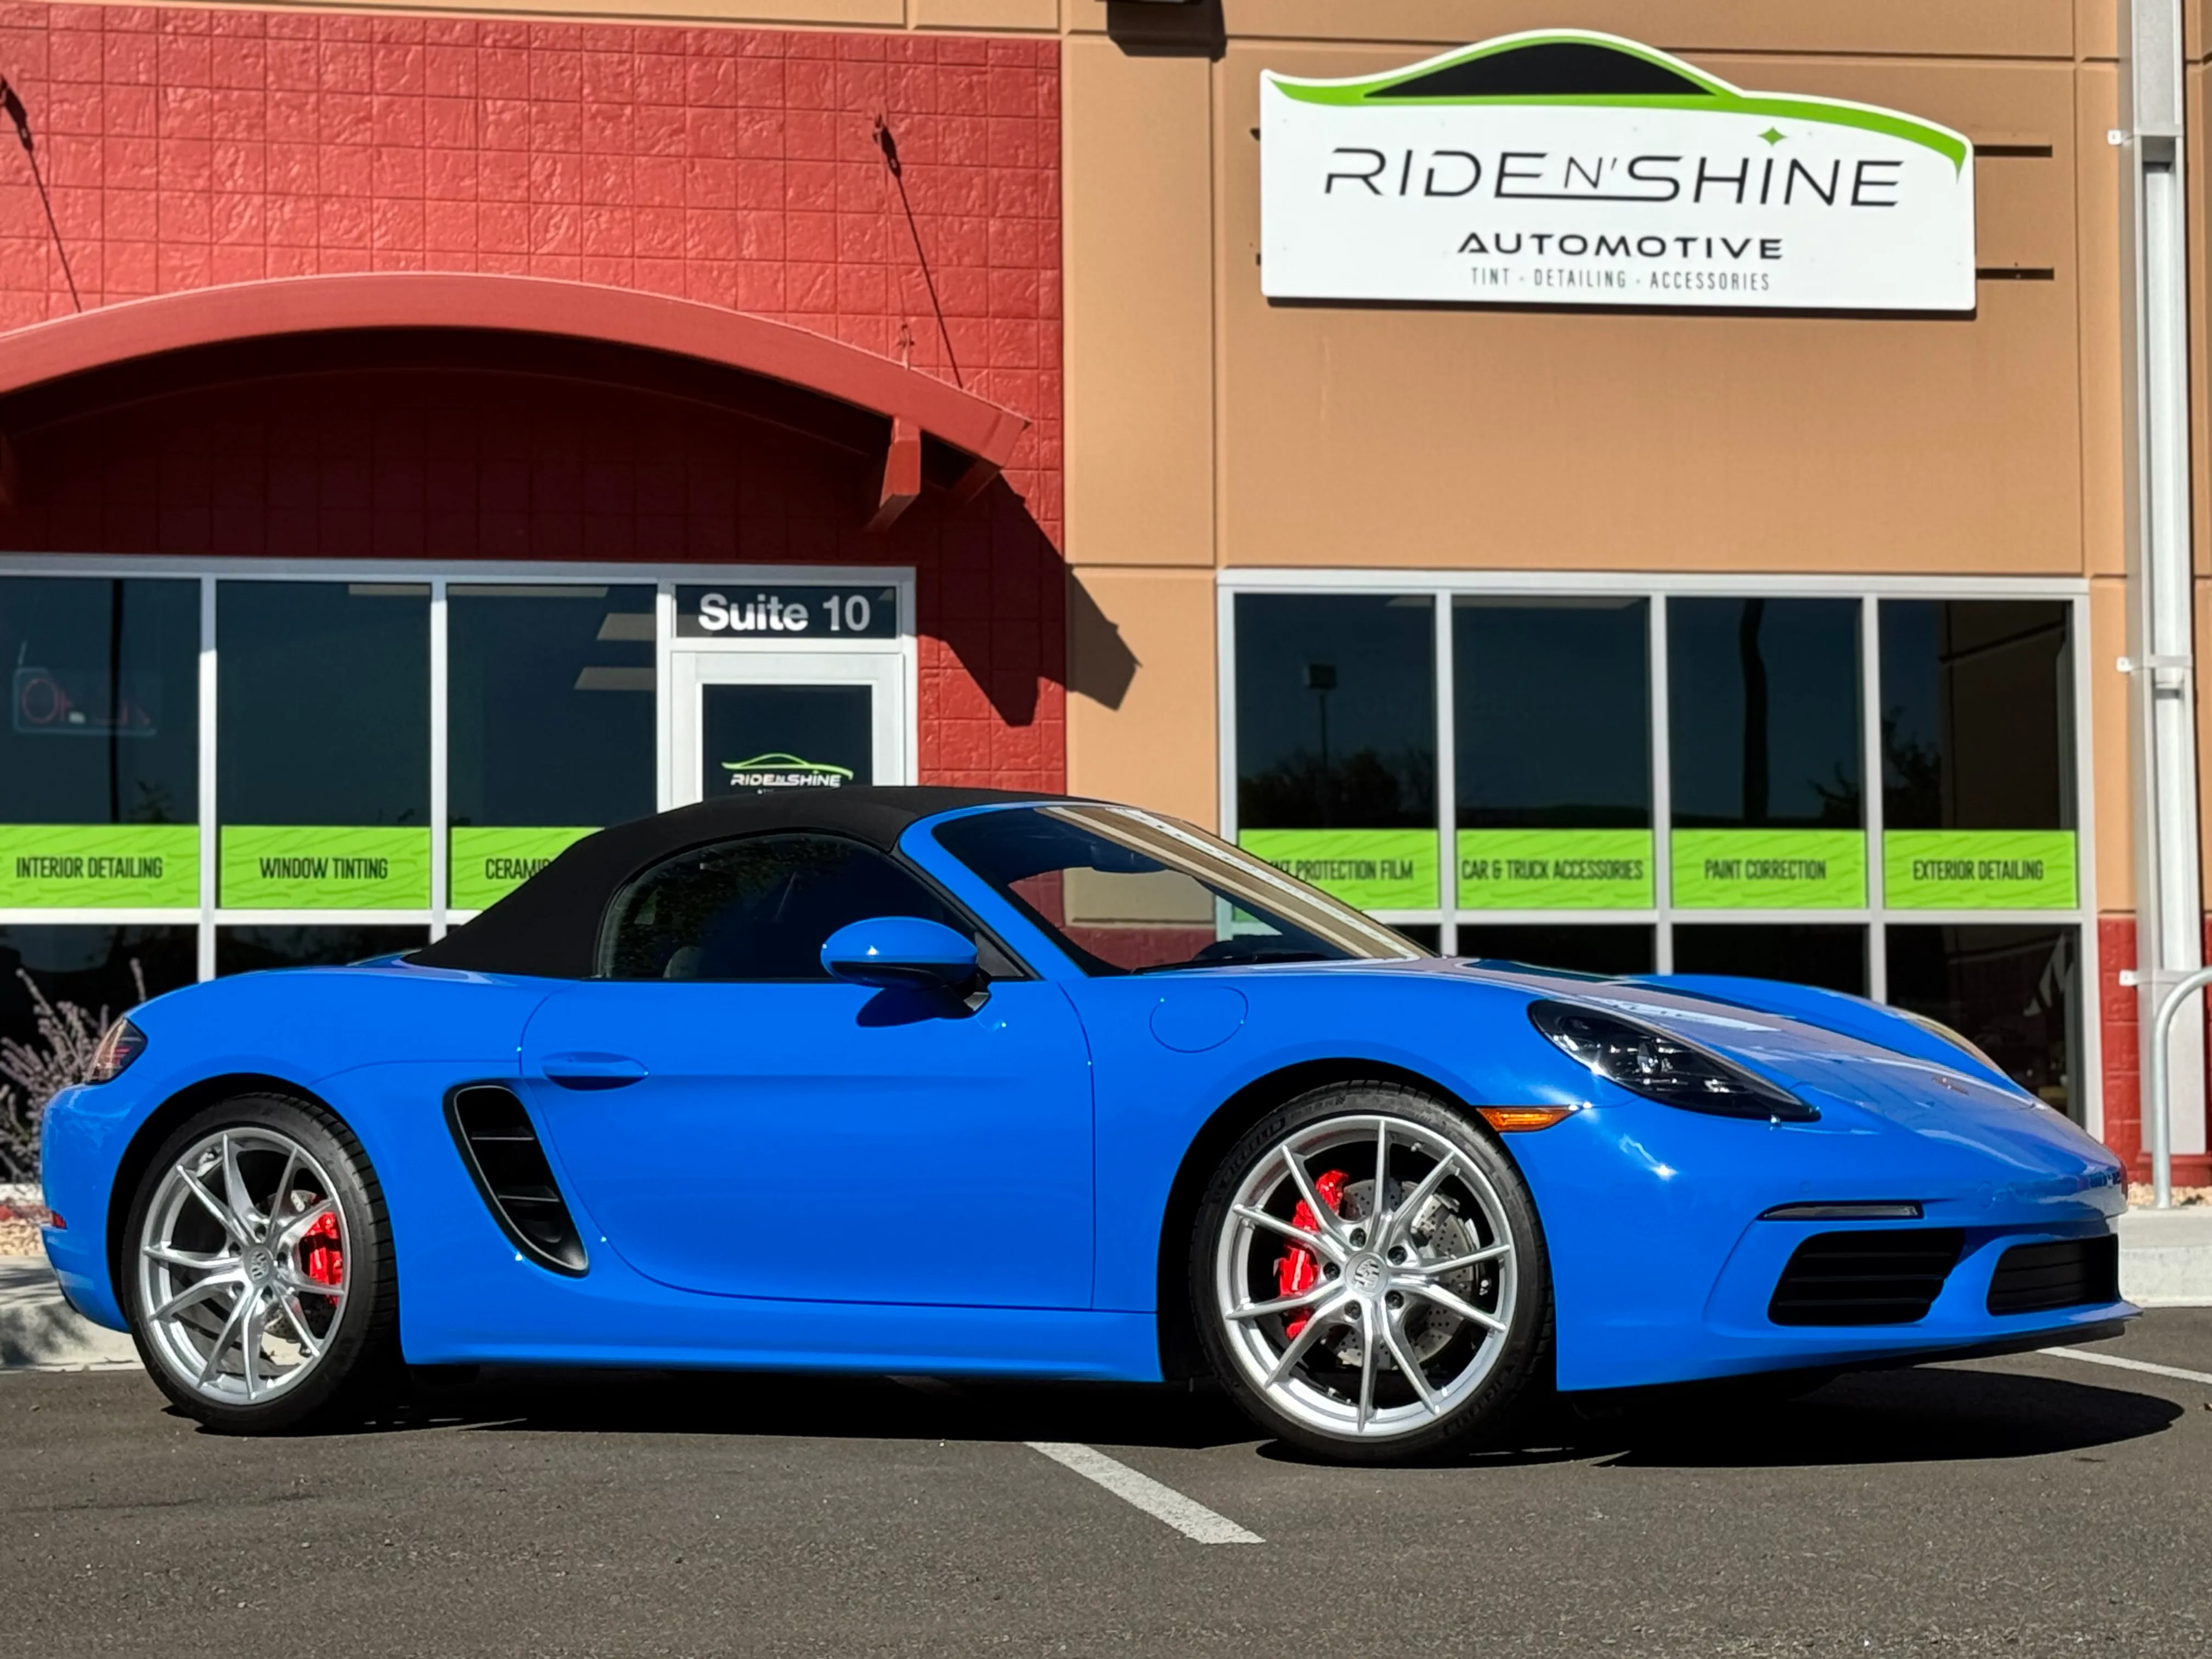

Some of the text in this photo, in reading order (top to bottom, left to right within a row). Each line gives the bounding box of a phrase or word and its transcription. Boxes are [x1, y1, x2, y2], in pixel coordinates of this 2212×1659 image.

[1325, 148, 1549, 198] RIDE
[1457, 232, 1784, 260] AUTOMOTIVE
[1471, 267, 1770, 291] TINT DETAILING ACCESSORIES
[698, 593, 871, 631] Suite 10
[730, 774, 775, 787] RIDE
[16, 856, 163, 879] INTERIOR DETAILING
[259, 857, 388, 879] WINDOW TINTING
[1295, 859, 1376, 881] PROTECTION
[1380, 860, 1414, 881] FILM
[1462, 859, 1644, 881] CAR & TRUCK ACCESSORIES
[1705, 859, 1826, 881] PAINT CORRECTION
[1912, 859, 2044, 881] EXTERIOR DETAILING
